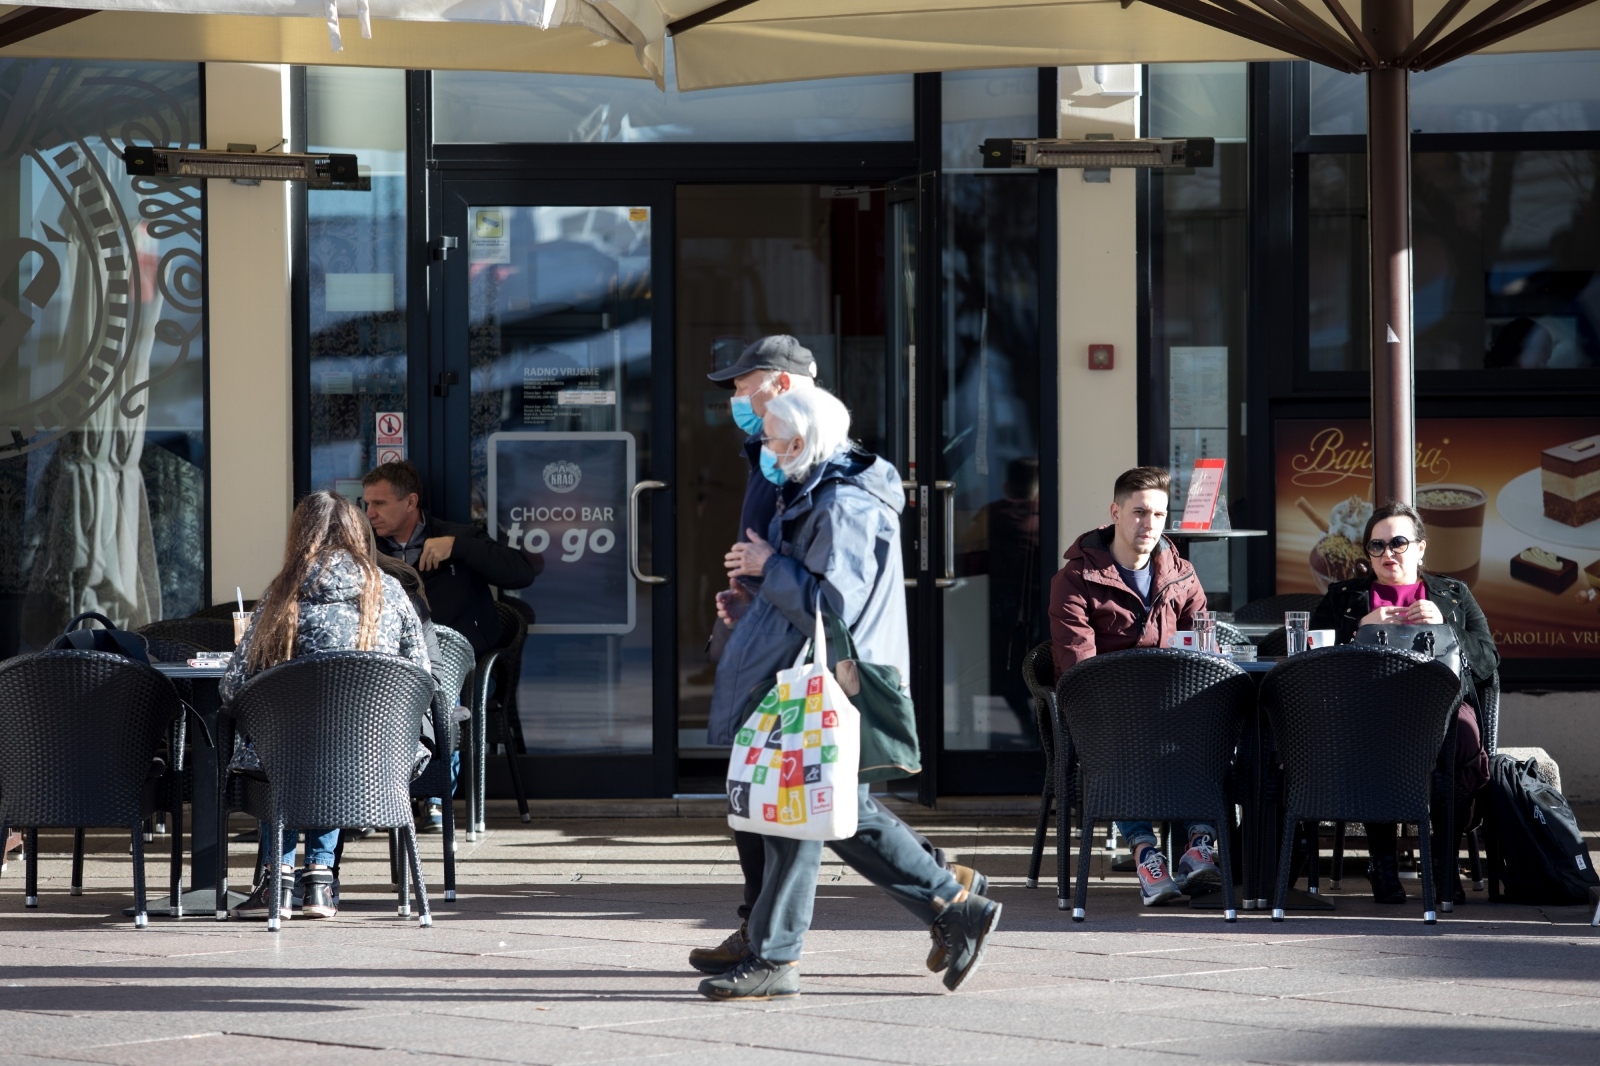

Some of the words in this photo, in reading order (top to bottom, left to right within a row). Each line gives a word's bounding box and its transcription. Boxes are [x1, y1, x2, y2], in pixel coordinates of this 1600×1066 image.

[523, 367, 558, 376] RADNO
[560, 367, 600, 376] VRIJEME
[510, 506, 576, 522] CHOCO
[581, 507, 614, 522] BAR
[507, 522, 550, 554] to
[561, 528, 616, 563] go
[1492, 629, 1566, 646] ČAROLIJA
